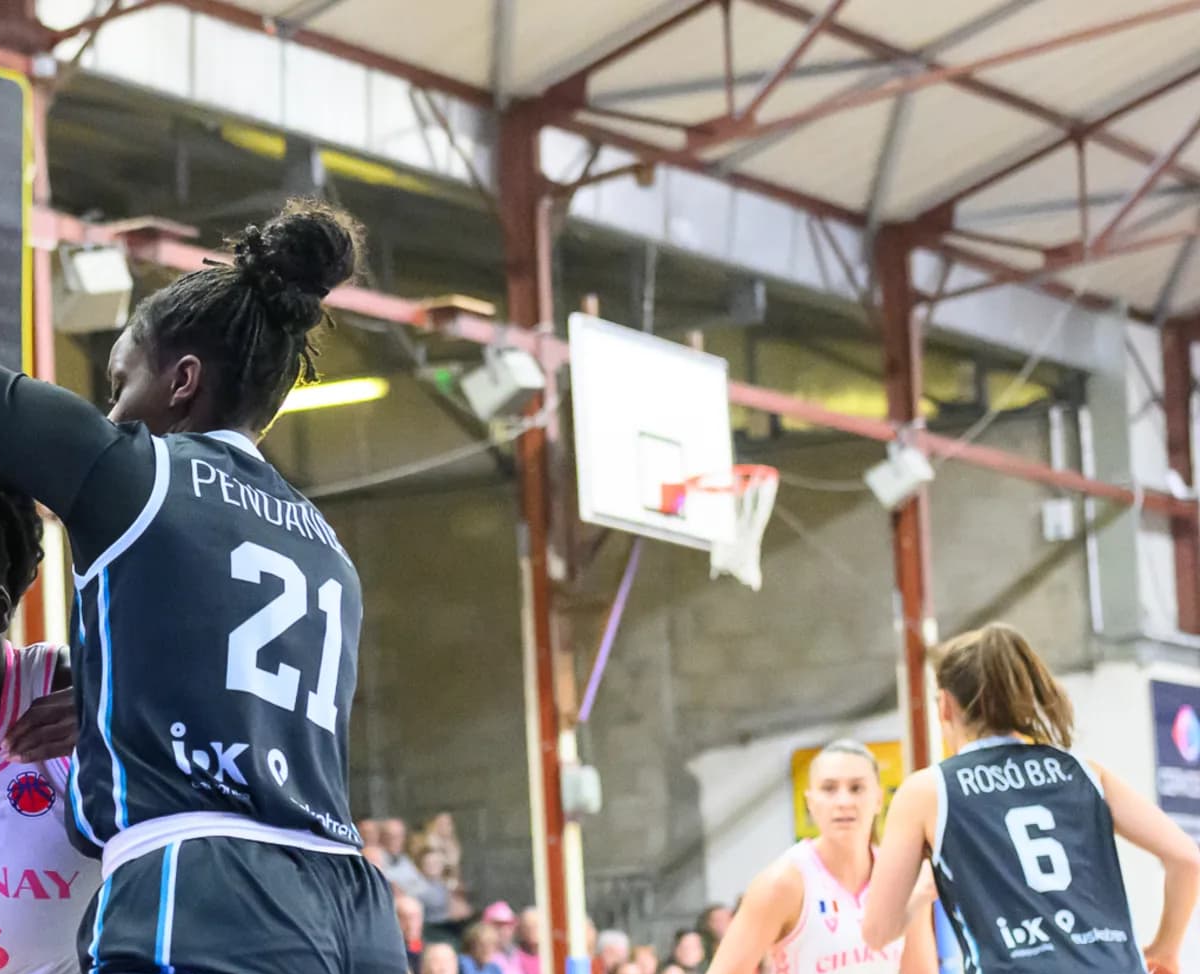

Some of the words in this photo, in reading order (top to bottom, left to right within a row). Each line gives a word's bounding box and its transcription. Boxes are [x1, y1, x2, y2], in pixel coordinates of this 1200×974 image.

[225, 540, 343, 735] 21
[956, 757, 1025, 796] ROSÓ
[1024, 757, 1073, 787] B.R.
[1004, 804, 1072, 894] 6
